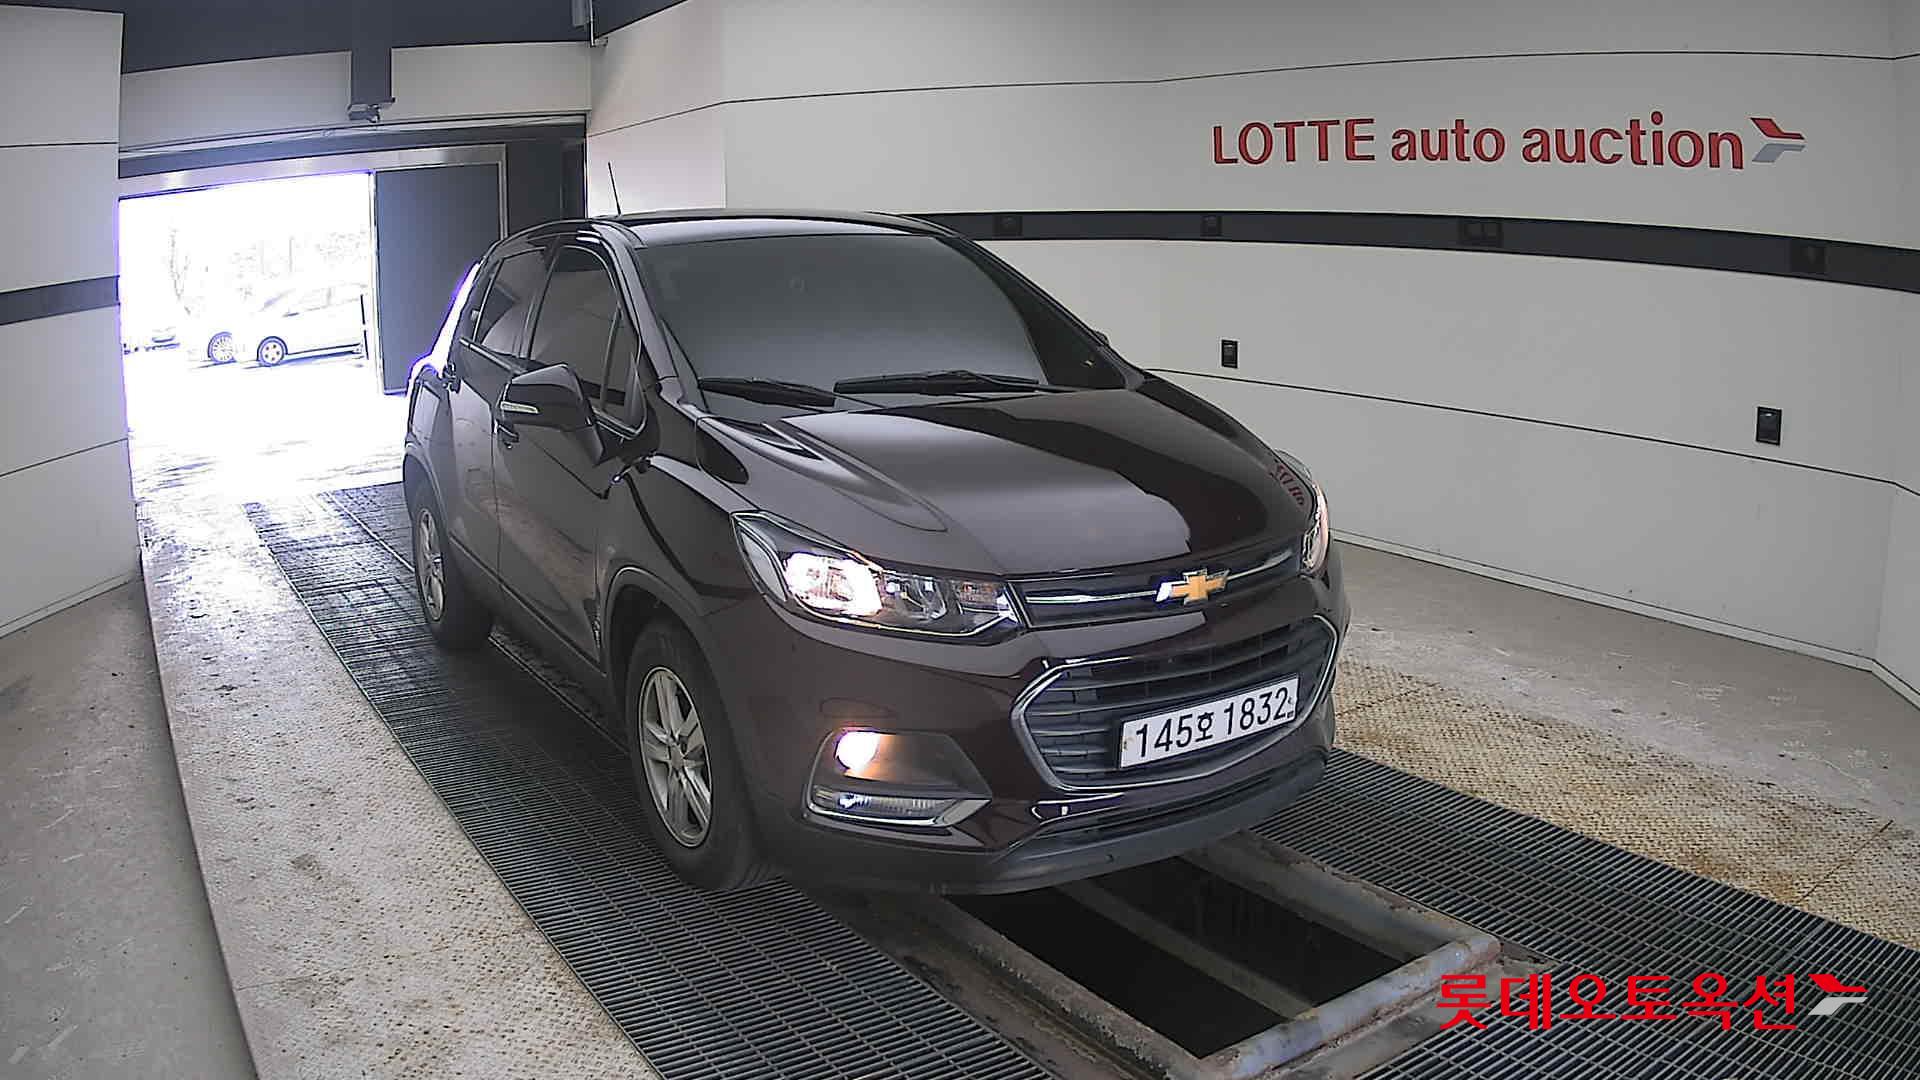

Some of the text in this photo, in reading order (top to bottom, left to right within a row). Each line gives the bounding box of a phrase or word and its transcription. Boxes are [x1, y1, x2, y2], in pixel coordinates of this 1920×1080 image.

[1213, 111, 1745, 170] LOTTE auto auction
[1135, 686, 1289, 758] 145호 1832
